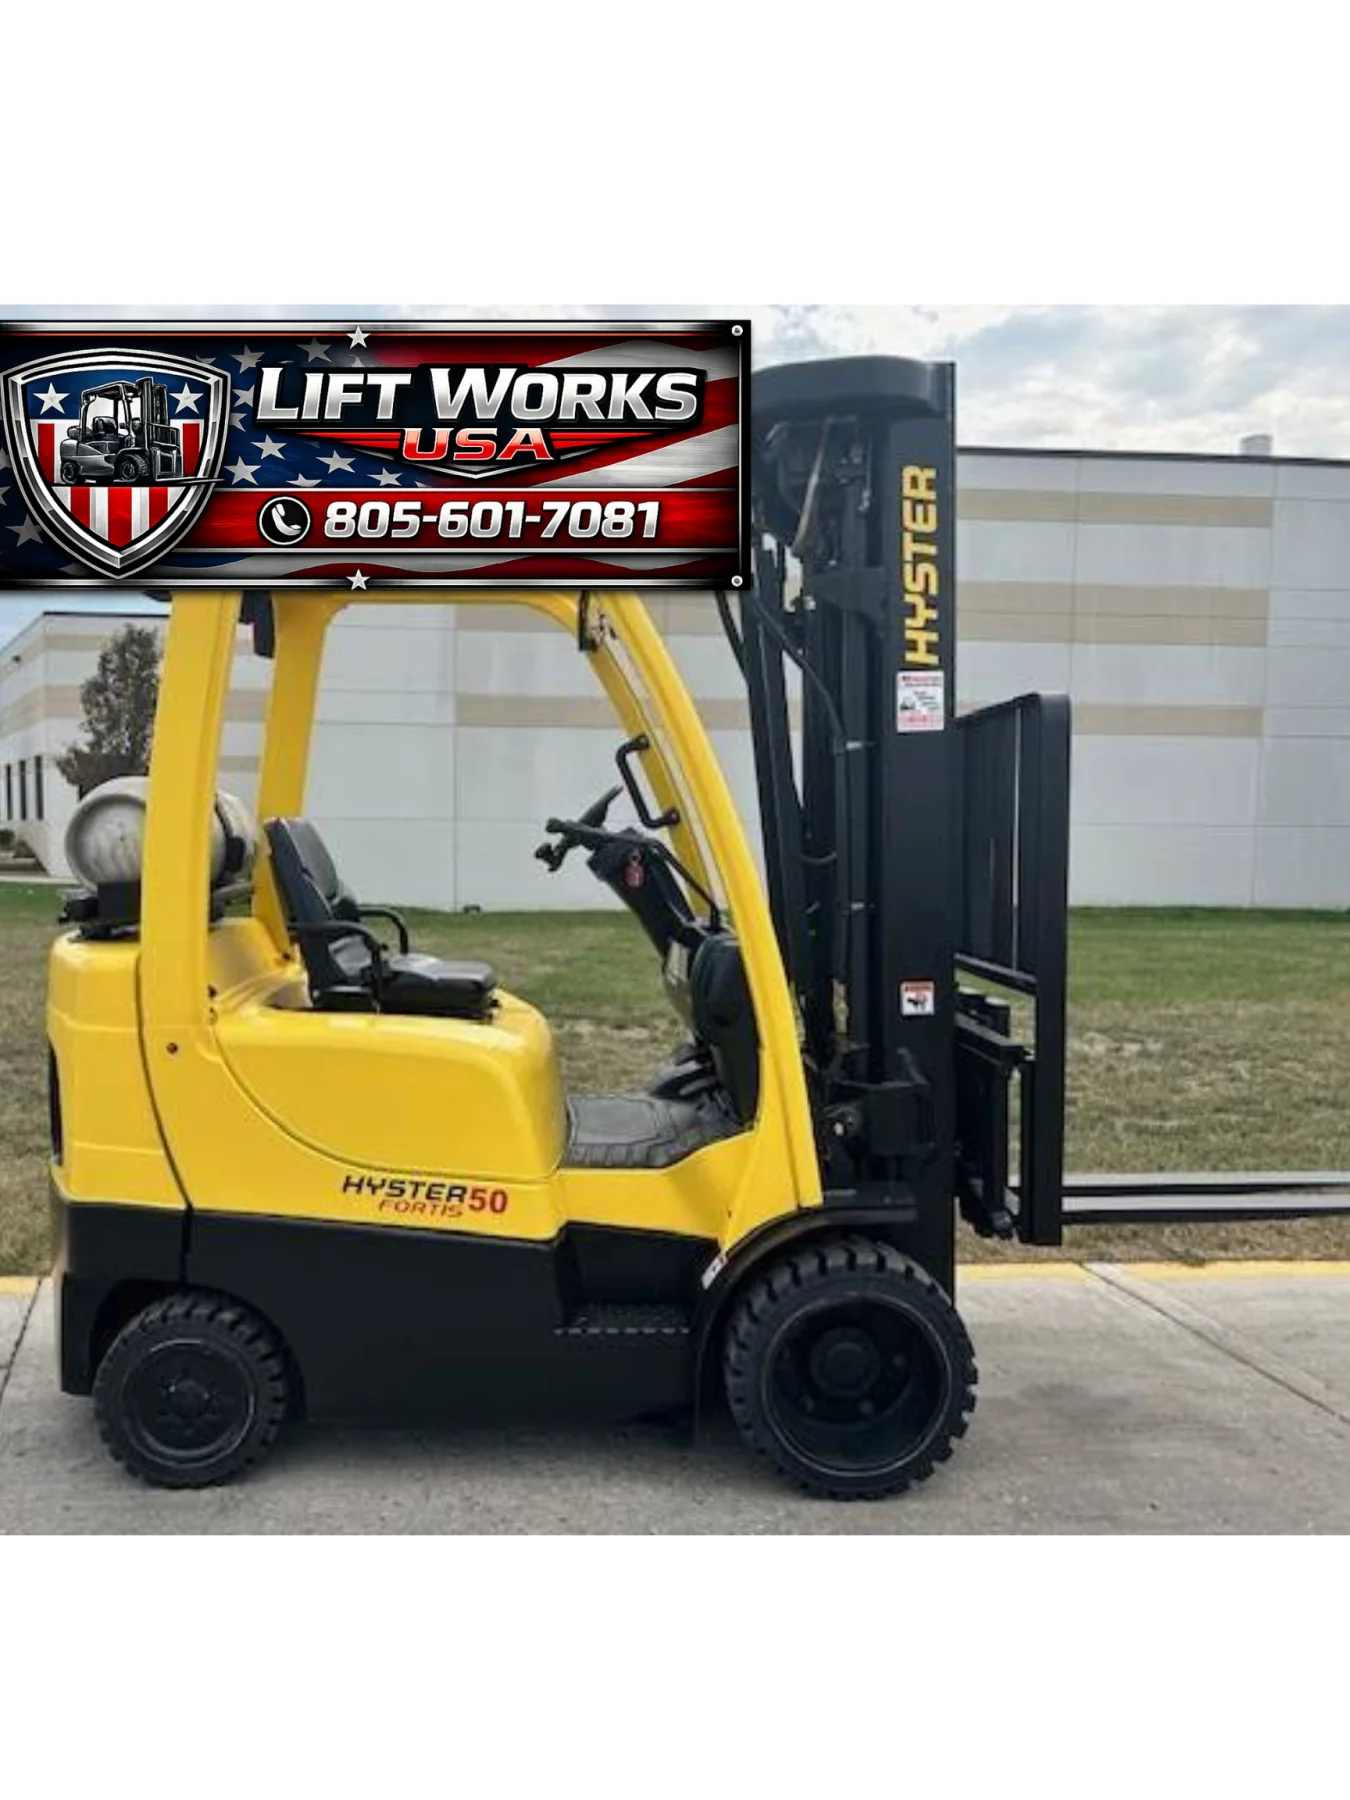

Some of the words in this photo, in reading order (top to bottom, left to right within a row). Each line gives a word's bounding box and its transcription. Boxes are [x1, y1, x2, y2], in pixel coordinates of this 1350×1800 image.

[902, 465, 940, 666] HYSTER
[342, 1175, 467, 1203] HYSTER
[468, 1187, 508, 1214] 50
[379, 1199, 463, 1218] FORTIS
